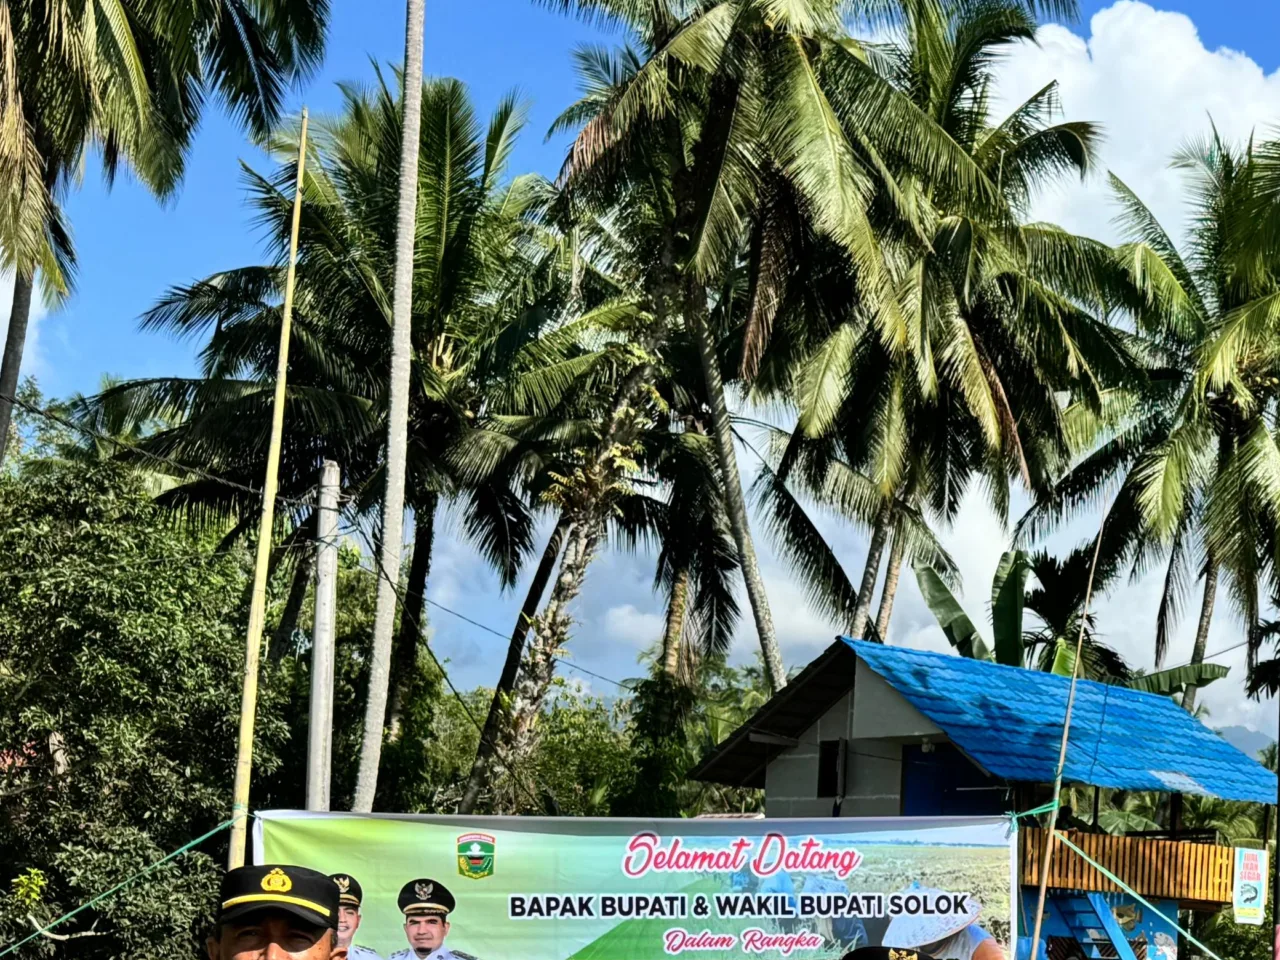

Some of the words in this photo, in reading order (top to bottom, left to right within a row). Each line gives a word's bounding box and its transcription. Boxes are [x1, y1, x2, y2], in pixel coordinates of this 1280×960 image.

[624, 833, 750, 876] Selamat
[753, 833, 860, 877] Datang
[510, 896, 595, 917] BAPAK
[601, 895, 686, 916] BUPATI
[693, 896, 709, 916] &
[715, 895, 793, 916] WAKIL
[801, 895, 882, 915] BUPATI
[890, 894, 969, 914] SOLOK
[665, 929, 735, 952] Dalam
[743, 929, 822, 953] Rangka
